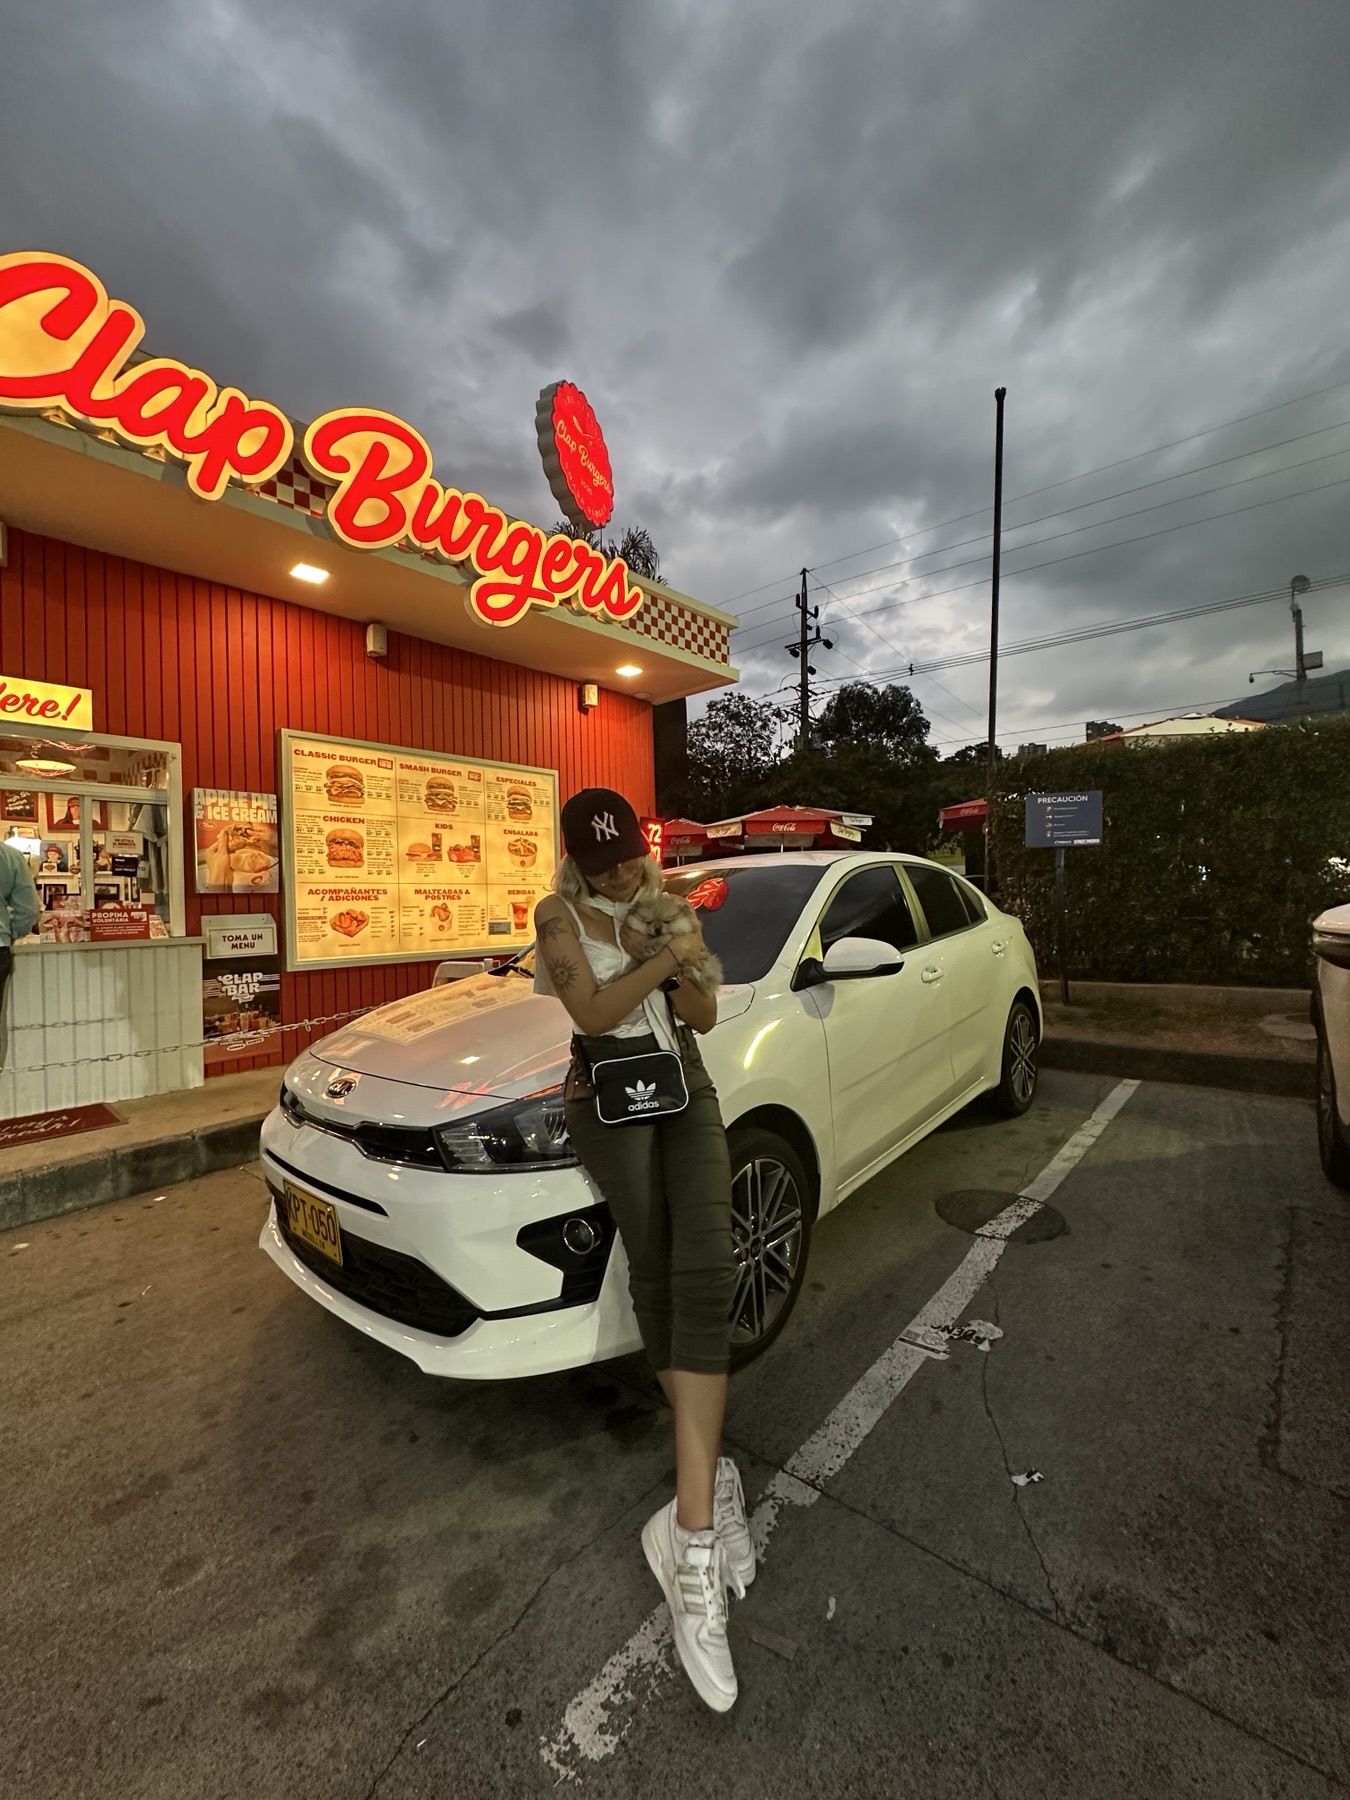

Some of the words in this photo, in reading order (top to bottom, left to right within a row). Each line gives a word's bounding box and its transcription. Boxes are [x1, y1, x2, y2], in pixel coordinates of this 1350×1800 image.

[0, 258, 288, 496] Clap
[309, 412, 645, 624] Burgers
[556, 419, 578, 453] Clap
[578, 444, 612, 495] Burgers
[293, 748, 338, 761] CLASSIC
[338, 754, 377, 766] BURGER
[399, 763, 430, 773] SMASH
[430, 767, 462, 777] BURGER
[496, 776, 537, 787] ESPECIALES
[194, 788, 248, 808] APPLE
[251, 792, 277, 810] PIE
[1037, 794, 1089, 804] PRECAUCIÓN
[207, 806, 230, 821] ICE
[231, 807, 278, 824] CREAM
[322, 815, 366, 825] CHICKEN
[591, 811, 620, 842] NY
[503, 829, 539, 837] ENSALADA
[307, 887, 388, 896] ACOMPAÑANTES
[91, 911, 129, 919] PROPINA
[221, 934, 249, 942] TOMA
[251, 933, 263, 941] UN
[230, 942, 256, 950] MENU
[217, 972, 263, 985] CLAP
[221, 983, 261, 996] BAR
[627, 1100, 660, 1112] adidas
